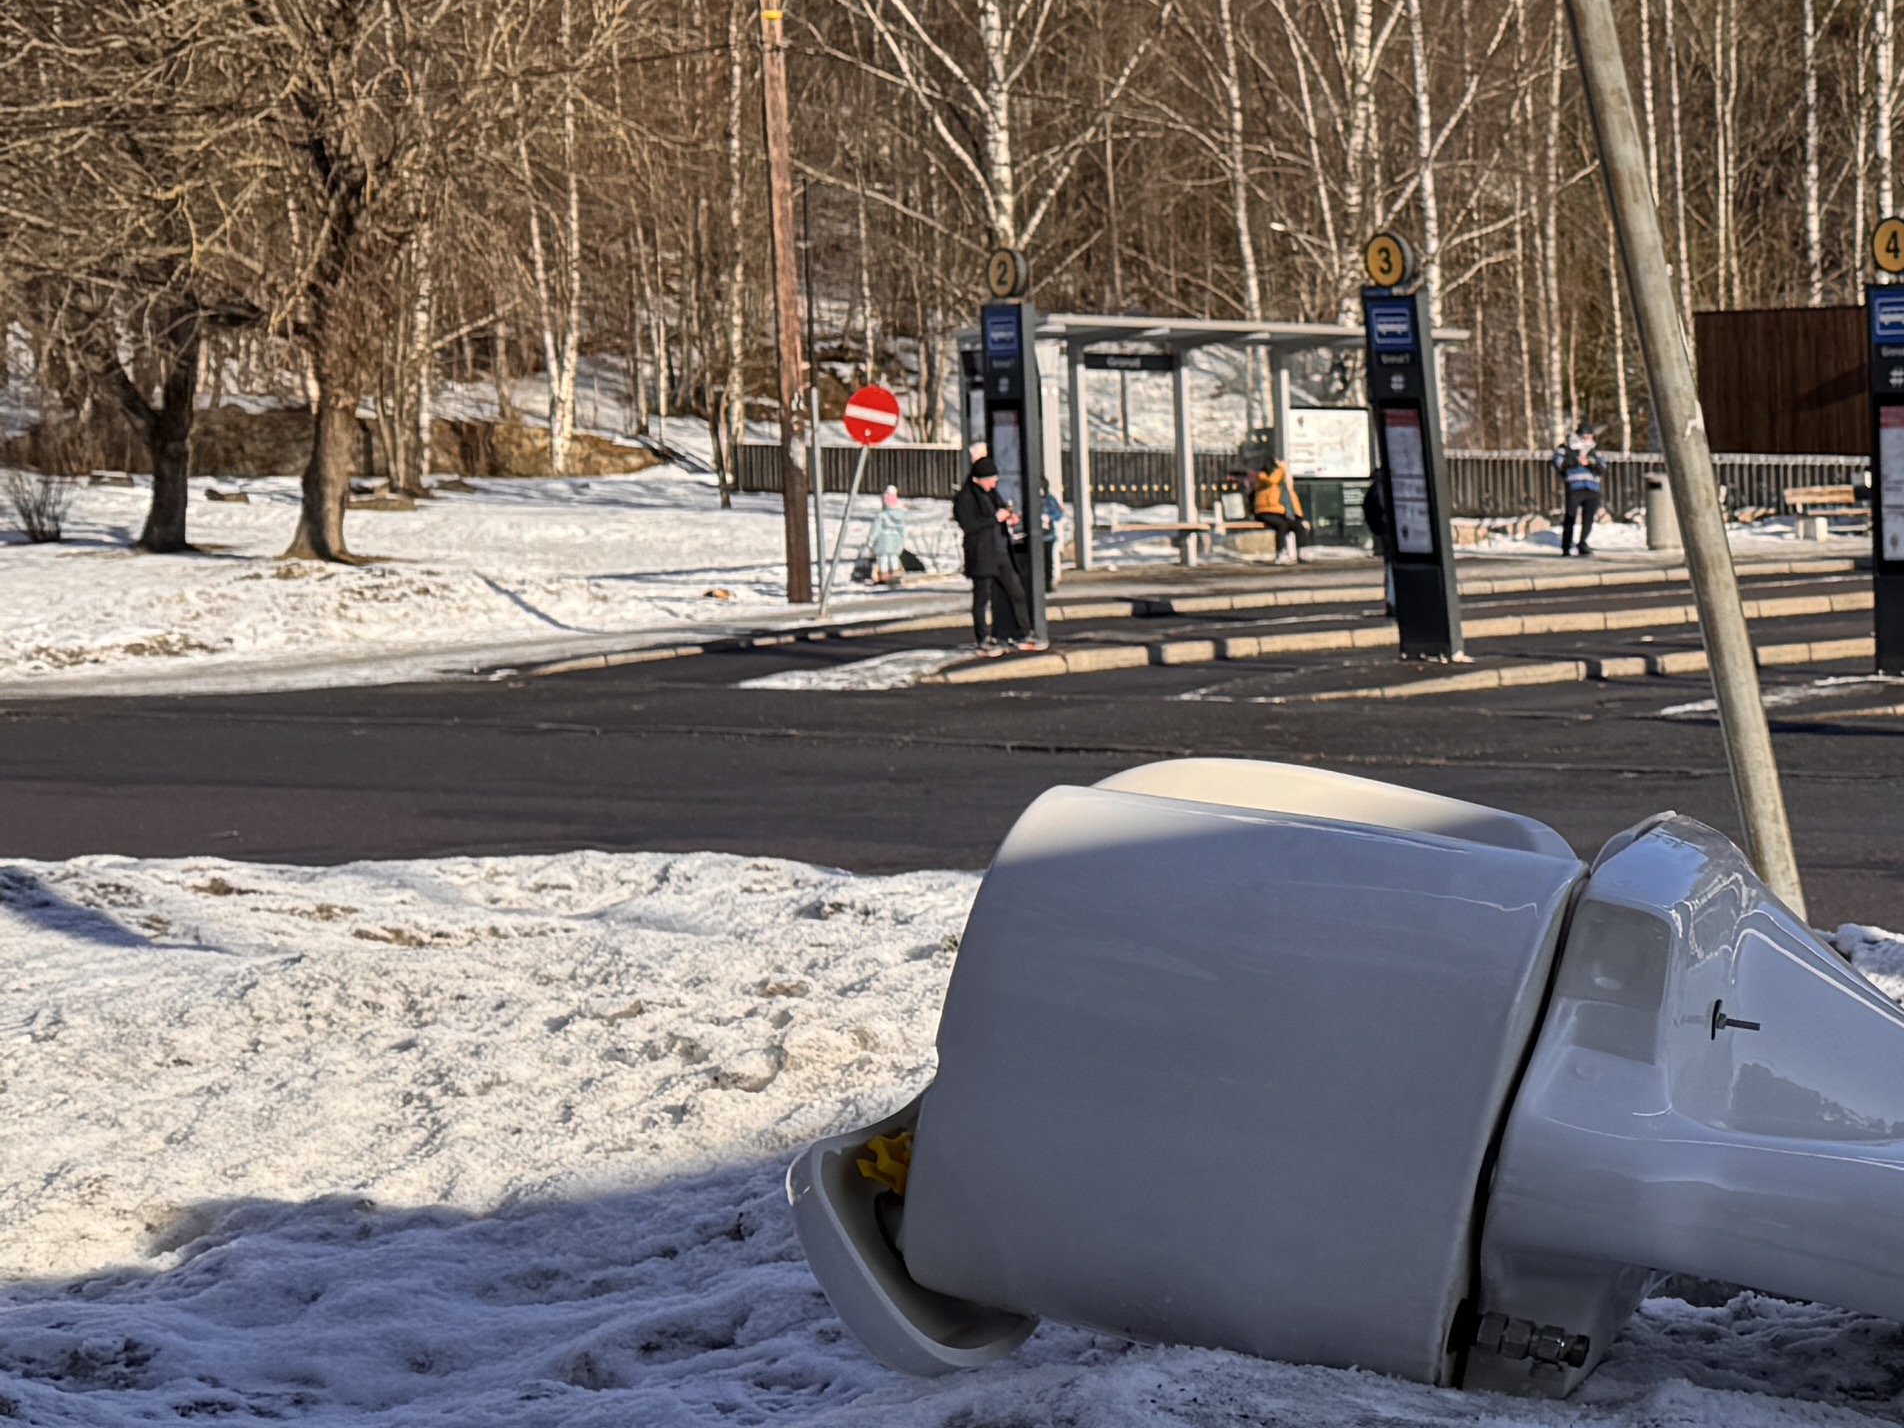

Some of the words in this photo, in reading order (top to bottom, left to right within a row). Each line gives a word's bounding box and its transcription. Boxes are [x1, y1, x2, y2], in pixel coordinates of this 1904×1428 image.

[1885, 230, 1902, 260] 4
[996, 261, 1008, 286] 2
[1377, 246, 1393, 275] 3
